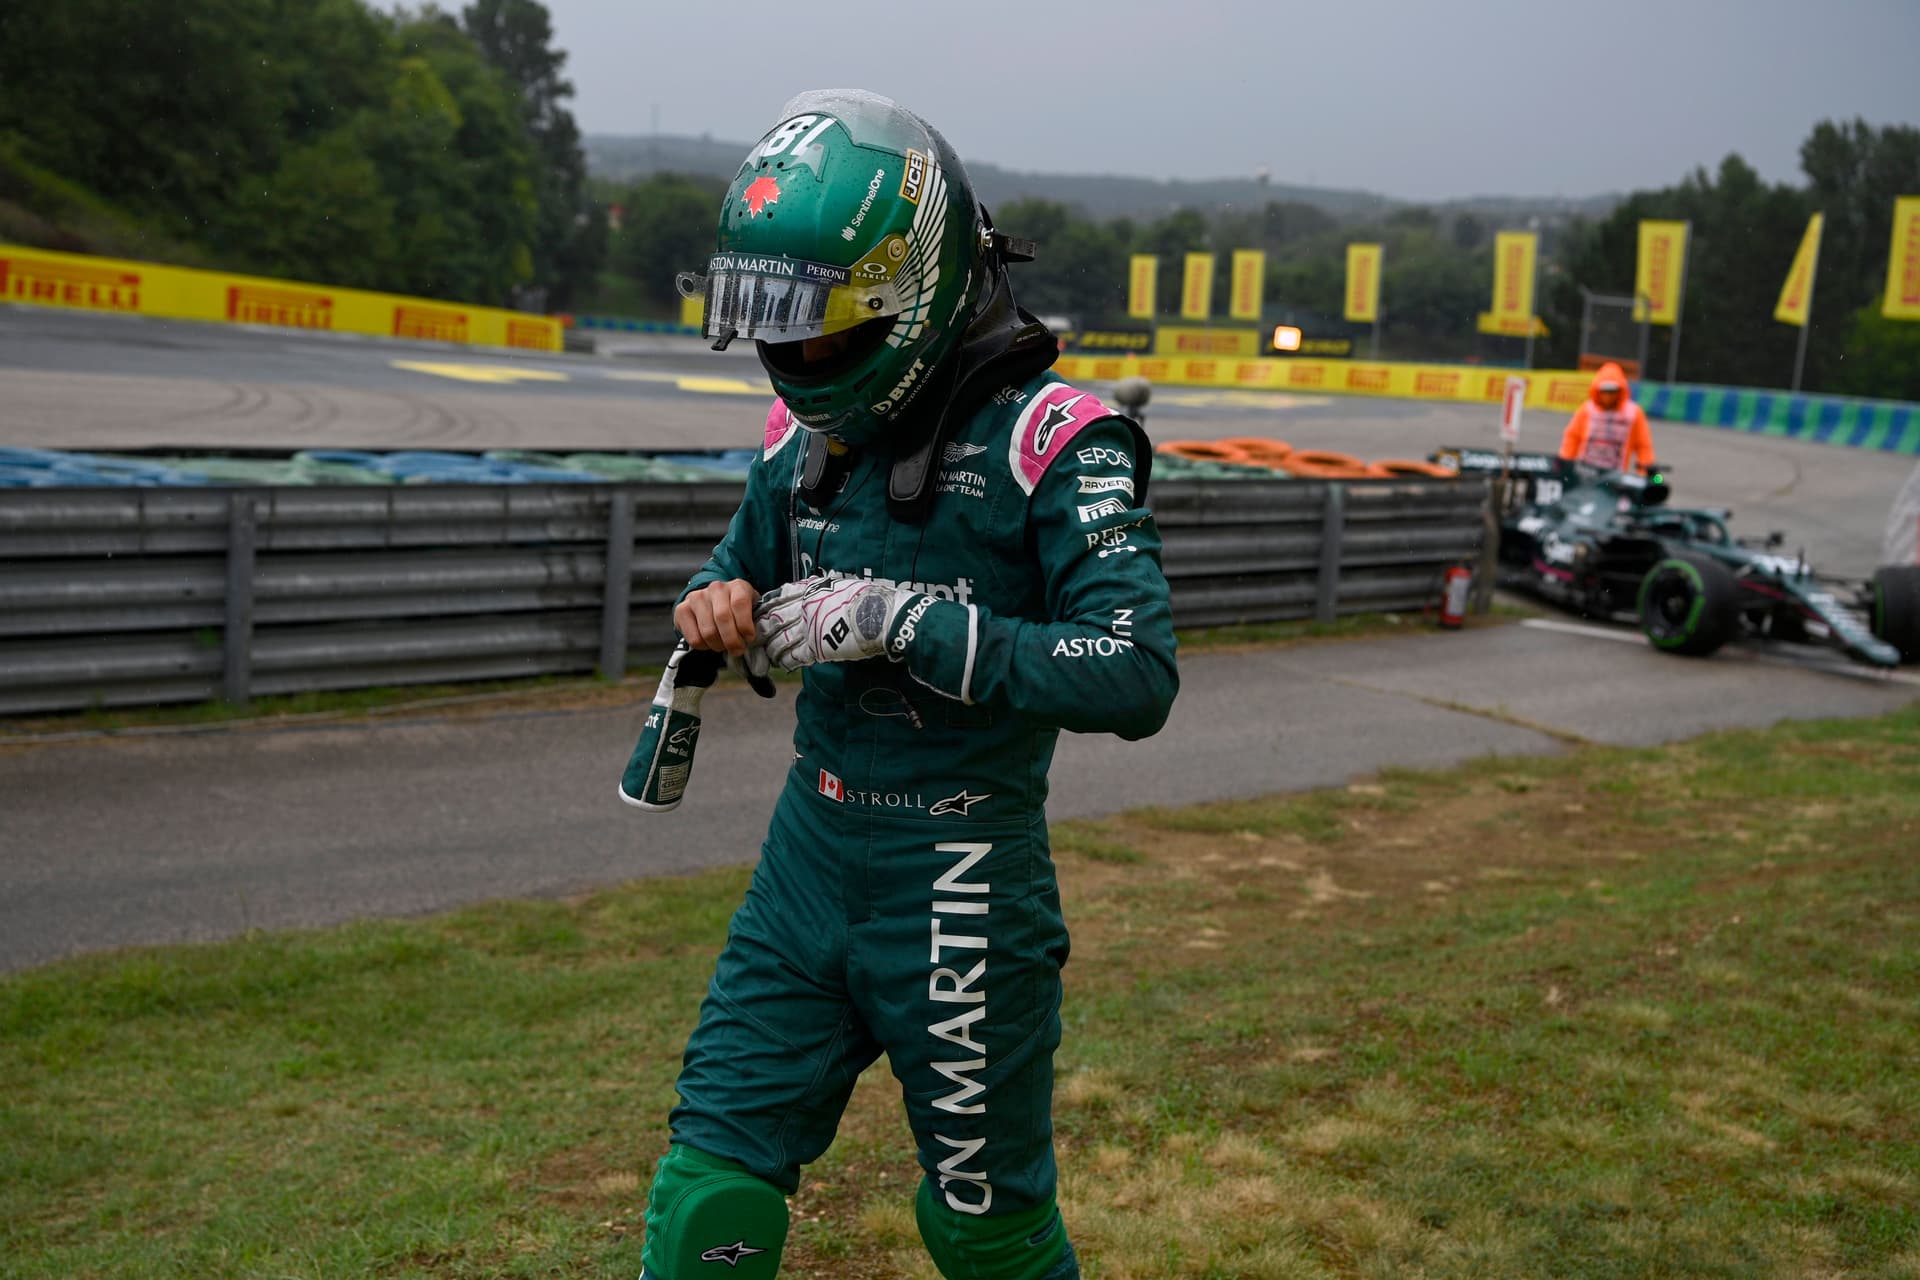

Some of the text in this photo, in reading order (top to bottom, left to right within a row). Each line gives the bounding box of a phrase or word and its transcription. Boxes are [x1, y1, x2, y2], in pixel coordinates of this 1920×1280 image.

[906, 153, 924, 198] JCB
[851, 168, 885, 227] SentinelOne
[737, 257, 795, 276] MARTIN
[806, 263, 847, 281] PERONI
[855, 271, 892, 281] OAKLEY
[226, 284, 335, 329] PIRELLI
[888, 358, 924, 401] BWT
[1076, 447, 1131, 468] EPOS
[960, 485, 984, 499] TEAM
[1084, 479, 1133, 493] RAVENO
[822, 617, 850, 651] 18
[846, 789, 926, 809] STROLL
[927, 842, 994, 1115] MARTIN
